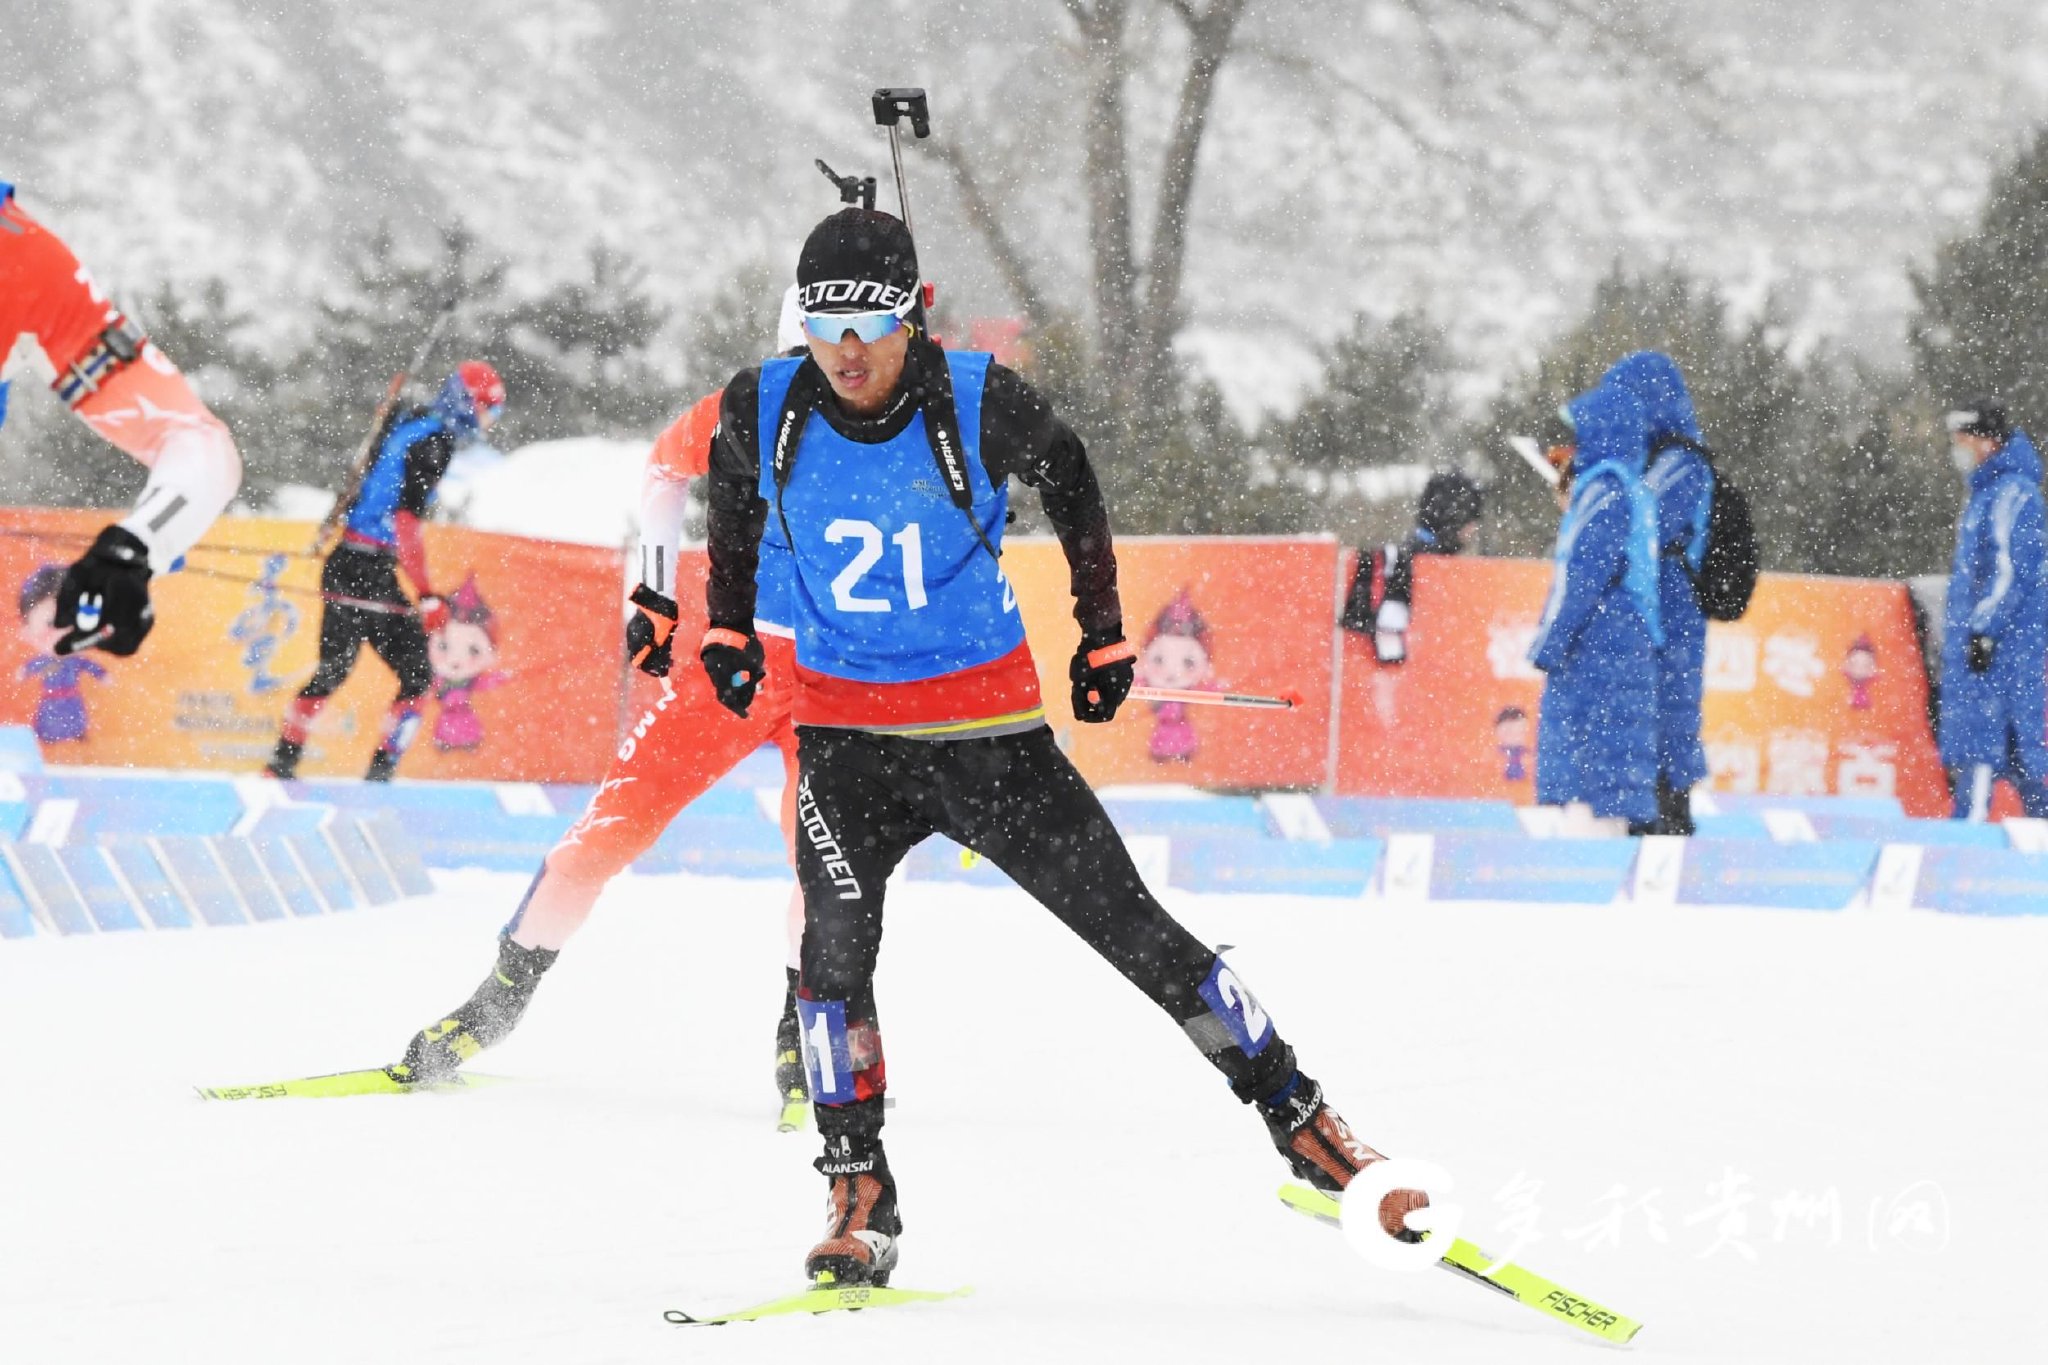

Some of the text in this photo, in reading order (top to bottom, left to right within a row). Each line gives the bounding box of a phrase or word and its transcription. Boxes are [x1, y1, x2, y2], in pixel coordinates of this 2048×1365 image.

[824, 518, 929, 613] 21
[821, 1159, 874, 1174] ALANSKI
[838, 1288, 871, 1304] FISCHER
[1540, 1290, 1617, 1332] FISCHER
